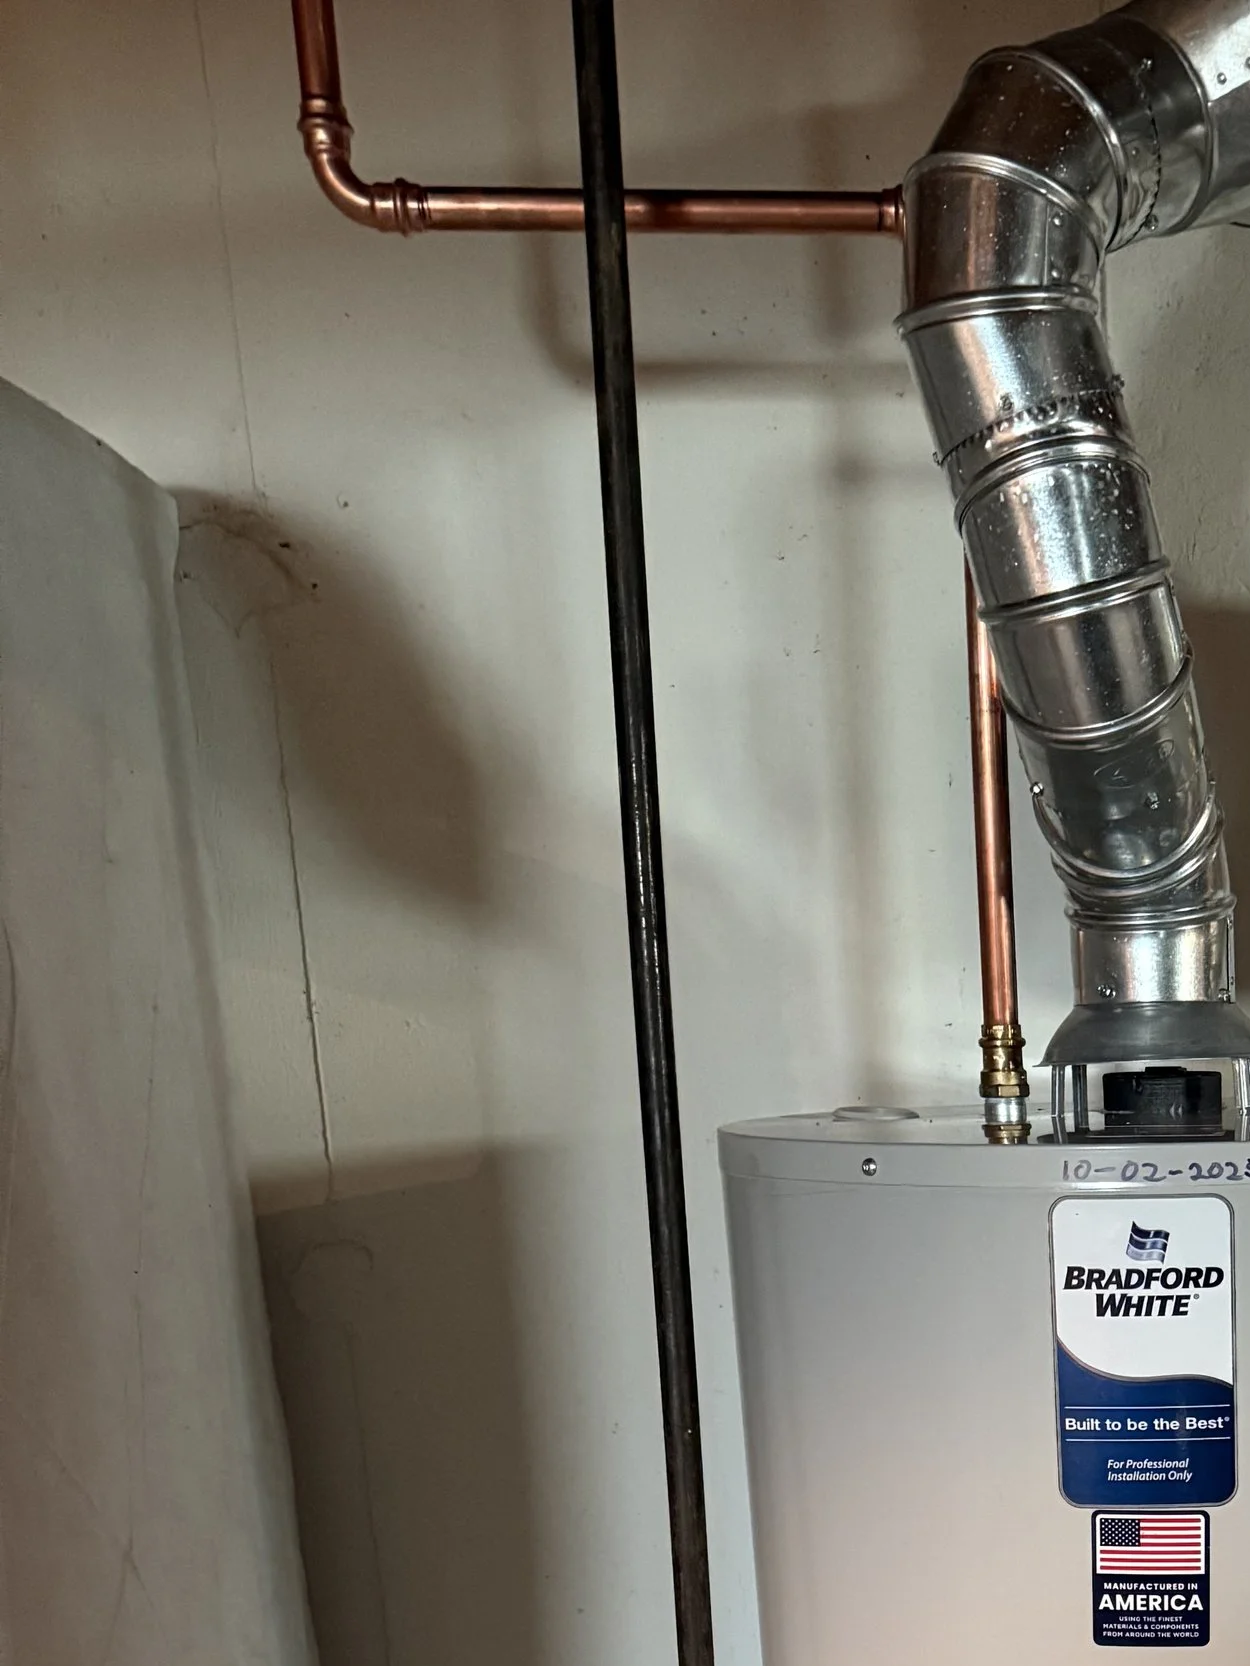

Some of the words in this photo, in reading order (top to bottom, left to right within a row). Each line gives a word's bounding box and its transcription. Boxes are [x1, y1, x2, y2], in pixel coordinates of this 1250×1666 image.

[1063, 1266, 1224, 1290] BRADFORD
[1065, 1418, 1101, 1430] Built
[1105, 1418, 1122, 1430] to
[1127, 1418, 1148, 1430] be
[1153, 1418, 1180, 1430] the
[1108, 1460, 1124, 1469] For
[1126, 1458, 1189, 1469] Professional
[1108, 1471, 1166, 1481] Installation
[1168, 1470, 1192, 1482] Only
[1098, 1594, 1204, 1611] AMERICA
